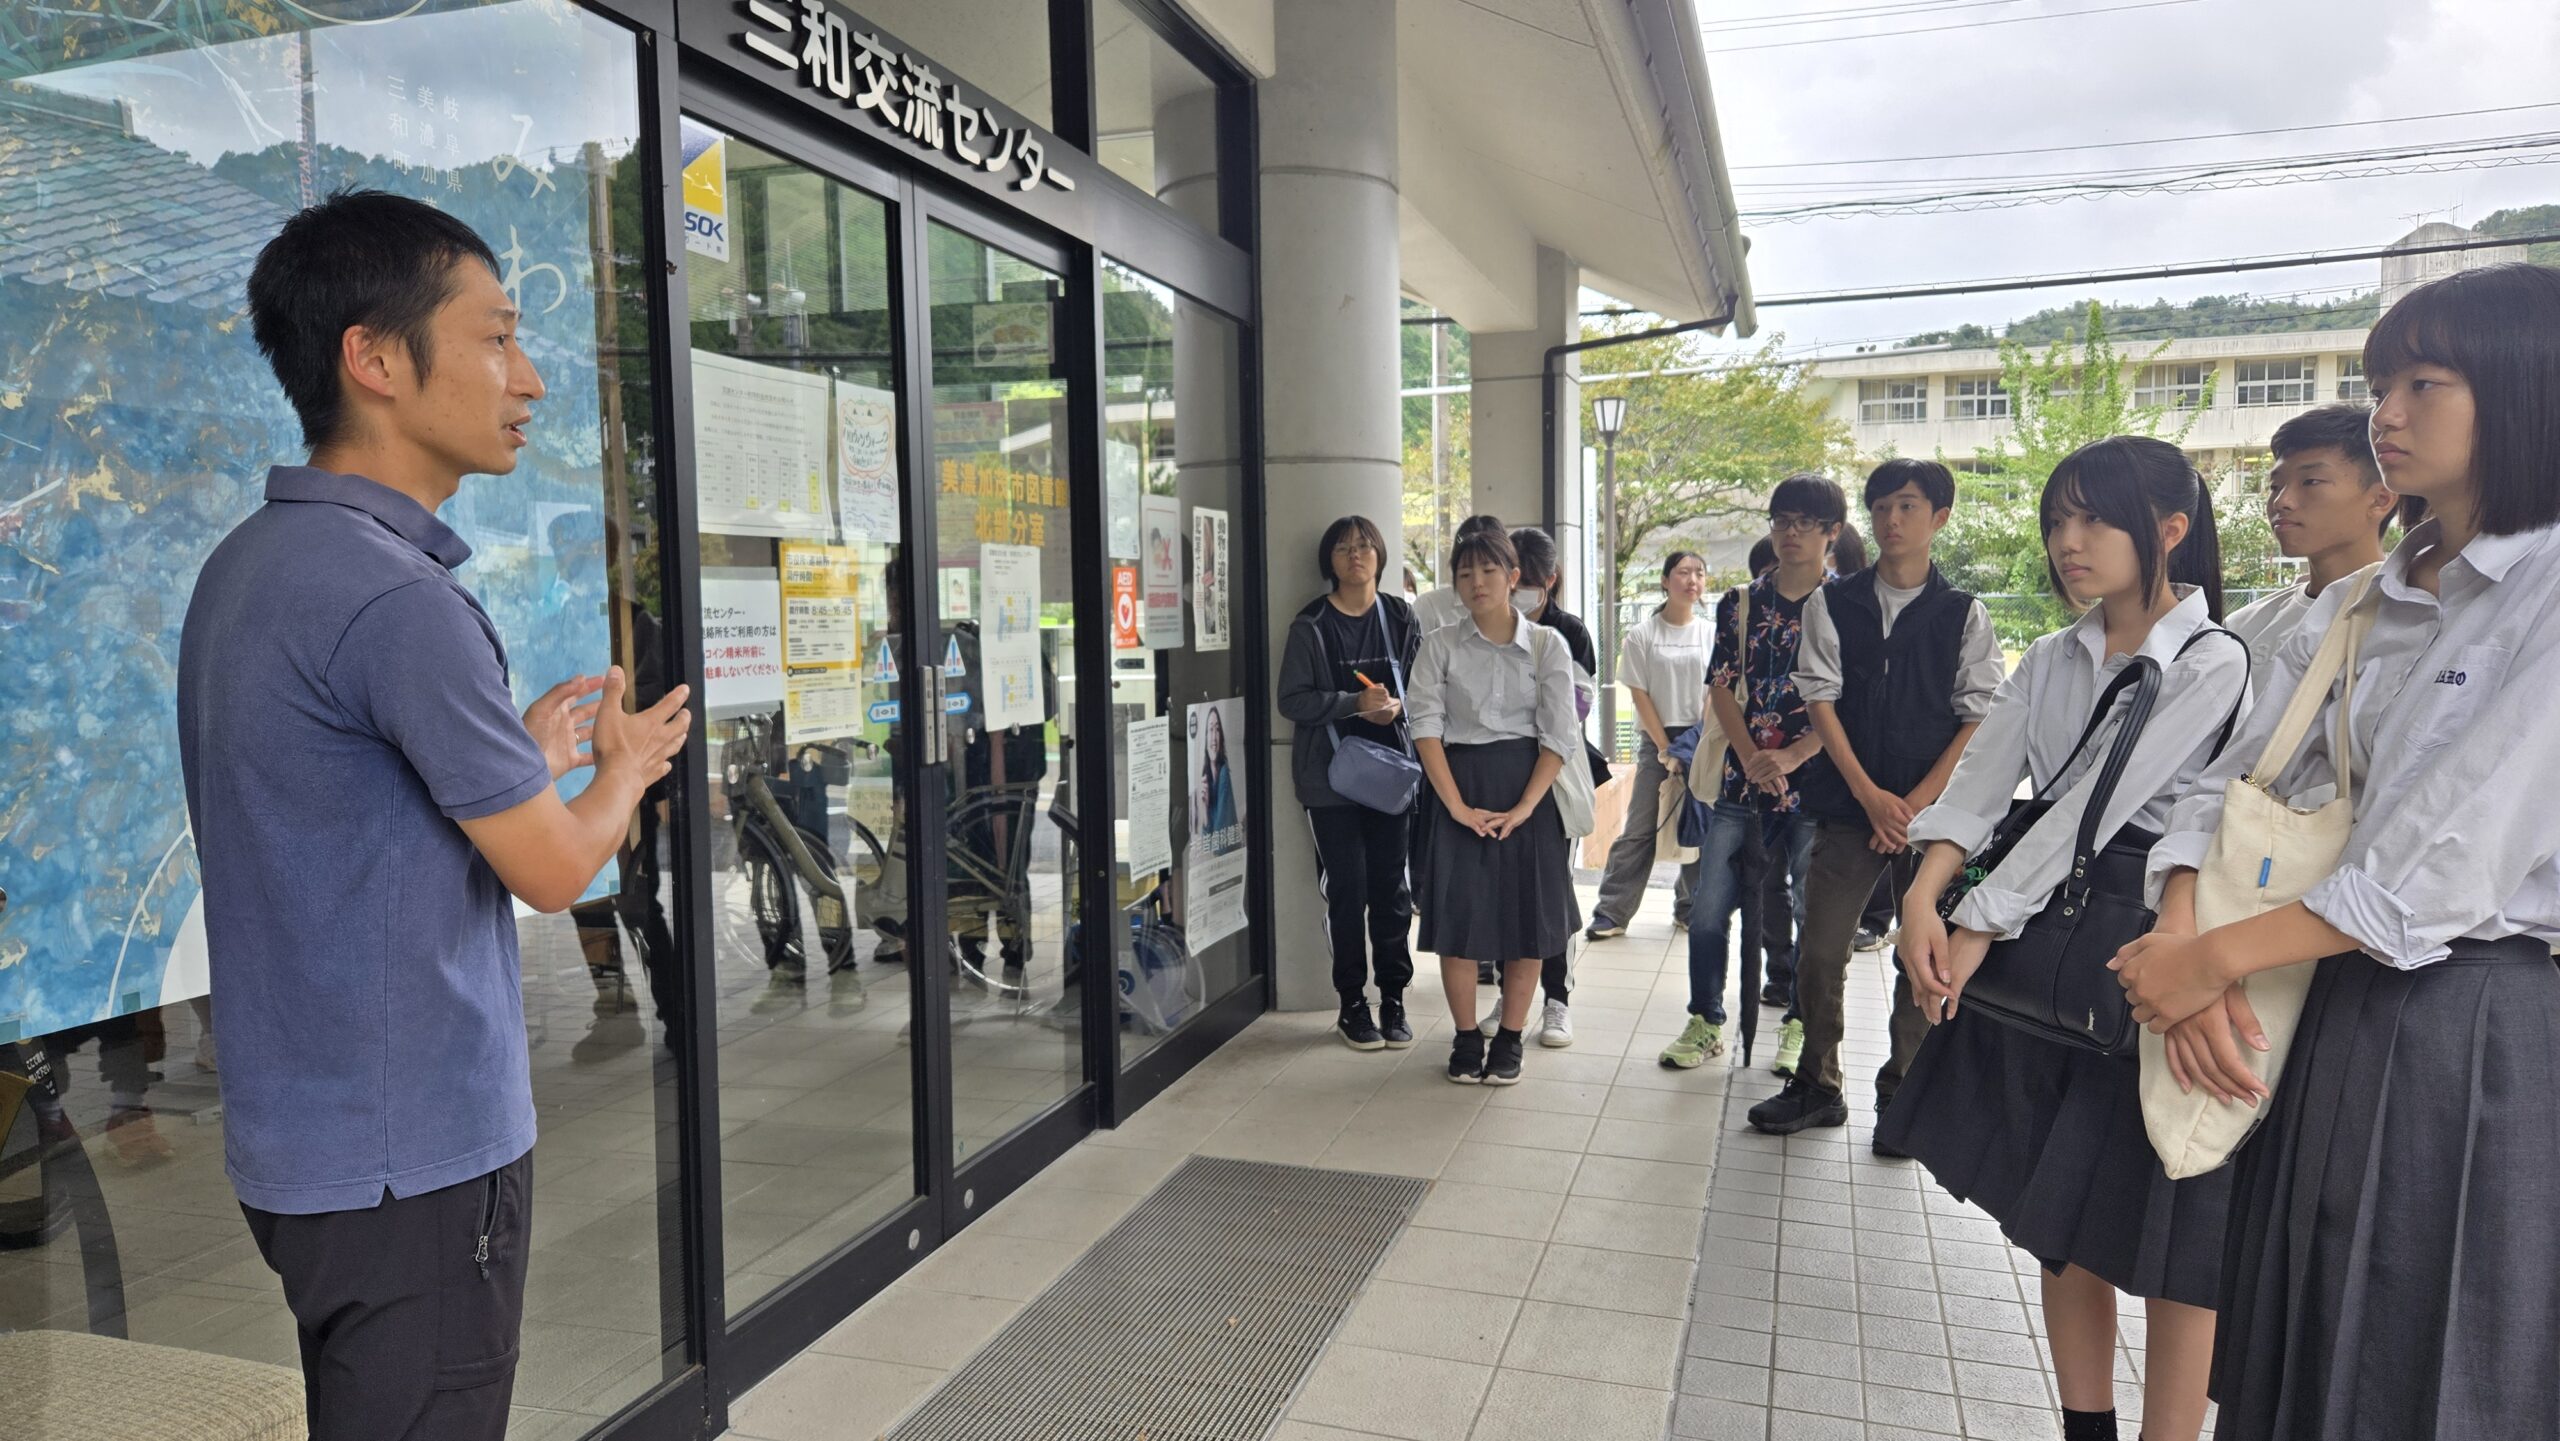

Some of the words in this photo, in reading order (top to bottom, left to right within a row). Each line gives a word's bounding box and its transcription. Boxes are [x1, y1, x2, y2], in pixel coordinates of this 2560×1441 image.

[387, 75, 412, 177] 三和町
[443, 95, 464, 193] 岐阜県
[744, 0, 1075, 192] 三和交流センター
[942, 459, 1068, 508] 美濃加茂市図書館
[975, 505, 1045, 548] 北部分室
